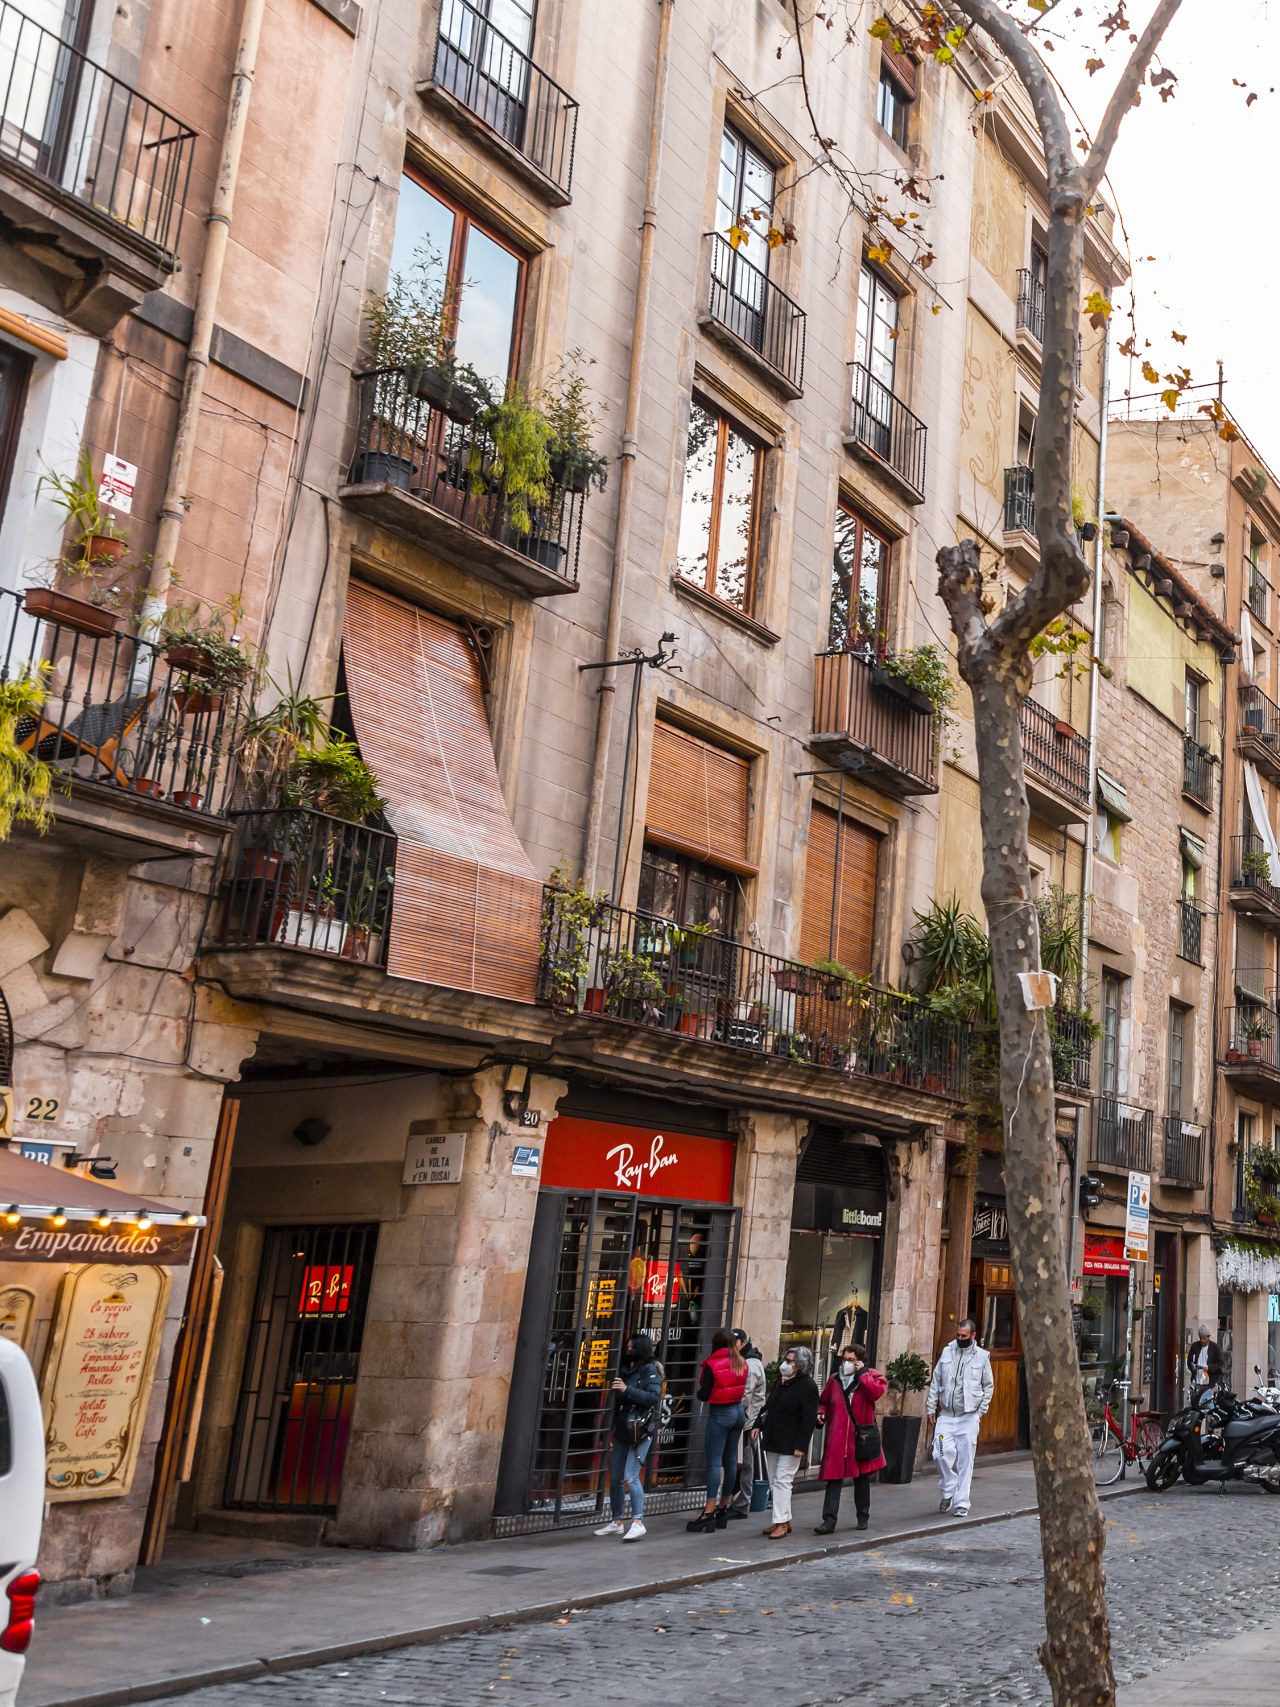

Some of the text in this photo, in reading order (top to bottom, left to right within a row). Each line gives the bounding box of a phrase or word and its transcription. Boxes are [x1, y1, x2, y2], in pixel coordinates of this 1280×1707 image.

[26, 1097, 59, 1121] 22
[524, 1111, 538, 1126] 20
[425, 1136, 446, 1144] CARRER
[415, 1157, 449, 1168] LA VOLTA
[1131, 1186, 1138, 1203] P
[14, 1226, 162, 1258] Empanadas
[83, 1325, 130, 1339] 28 sabors
[82, 1349, 130, 1364] Empanades
[79, 1362, 123, 1375] Amanides
